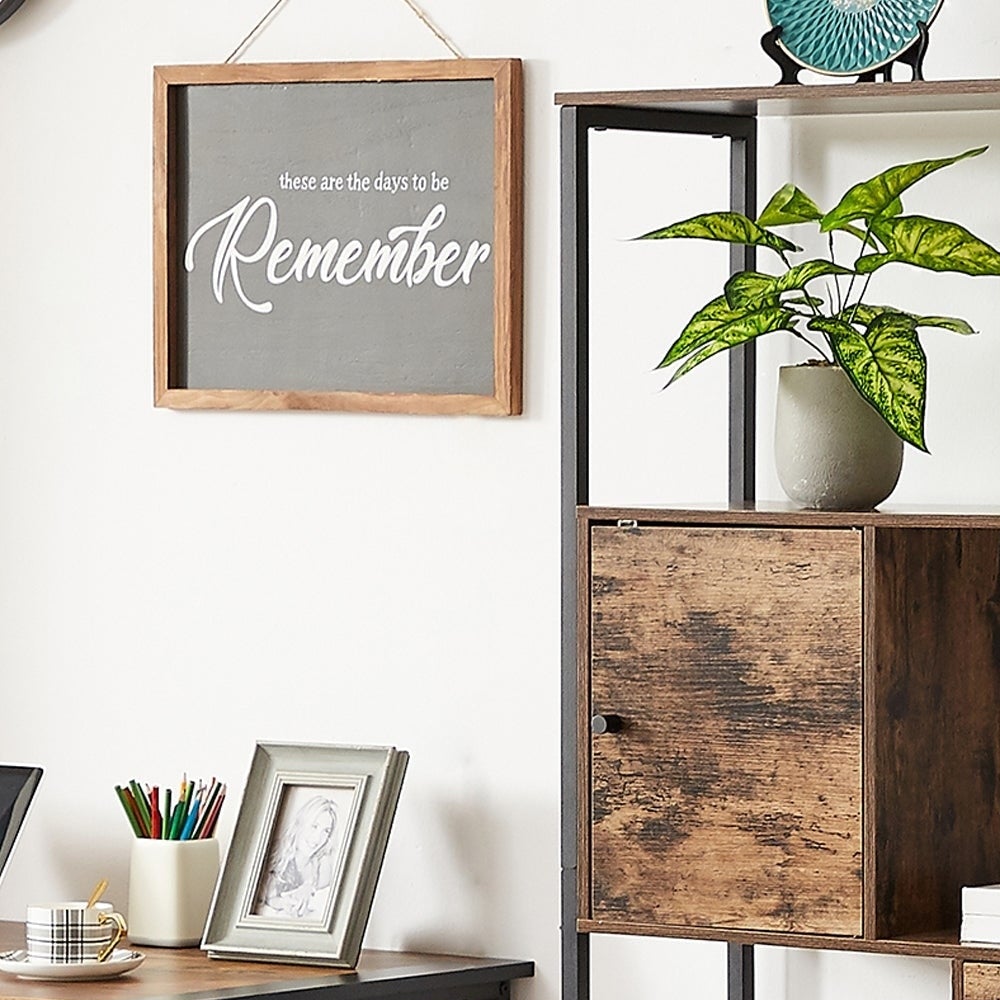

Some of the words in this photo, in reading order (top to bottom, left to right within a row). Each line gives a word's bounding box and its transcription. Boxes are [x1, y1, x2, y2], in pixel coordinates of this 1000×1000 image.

[279, 171, 317, 191] these
[320, 174, 344, 191] are
[347, 172, 370, 192] the
[374, 171, 409, 195] days
[412, 173, 427, 192] to
[431, 171, 450, 191] be
[185, 195, 491, 313] Remember
